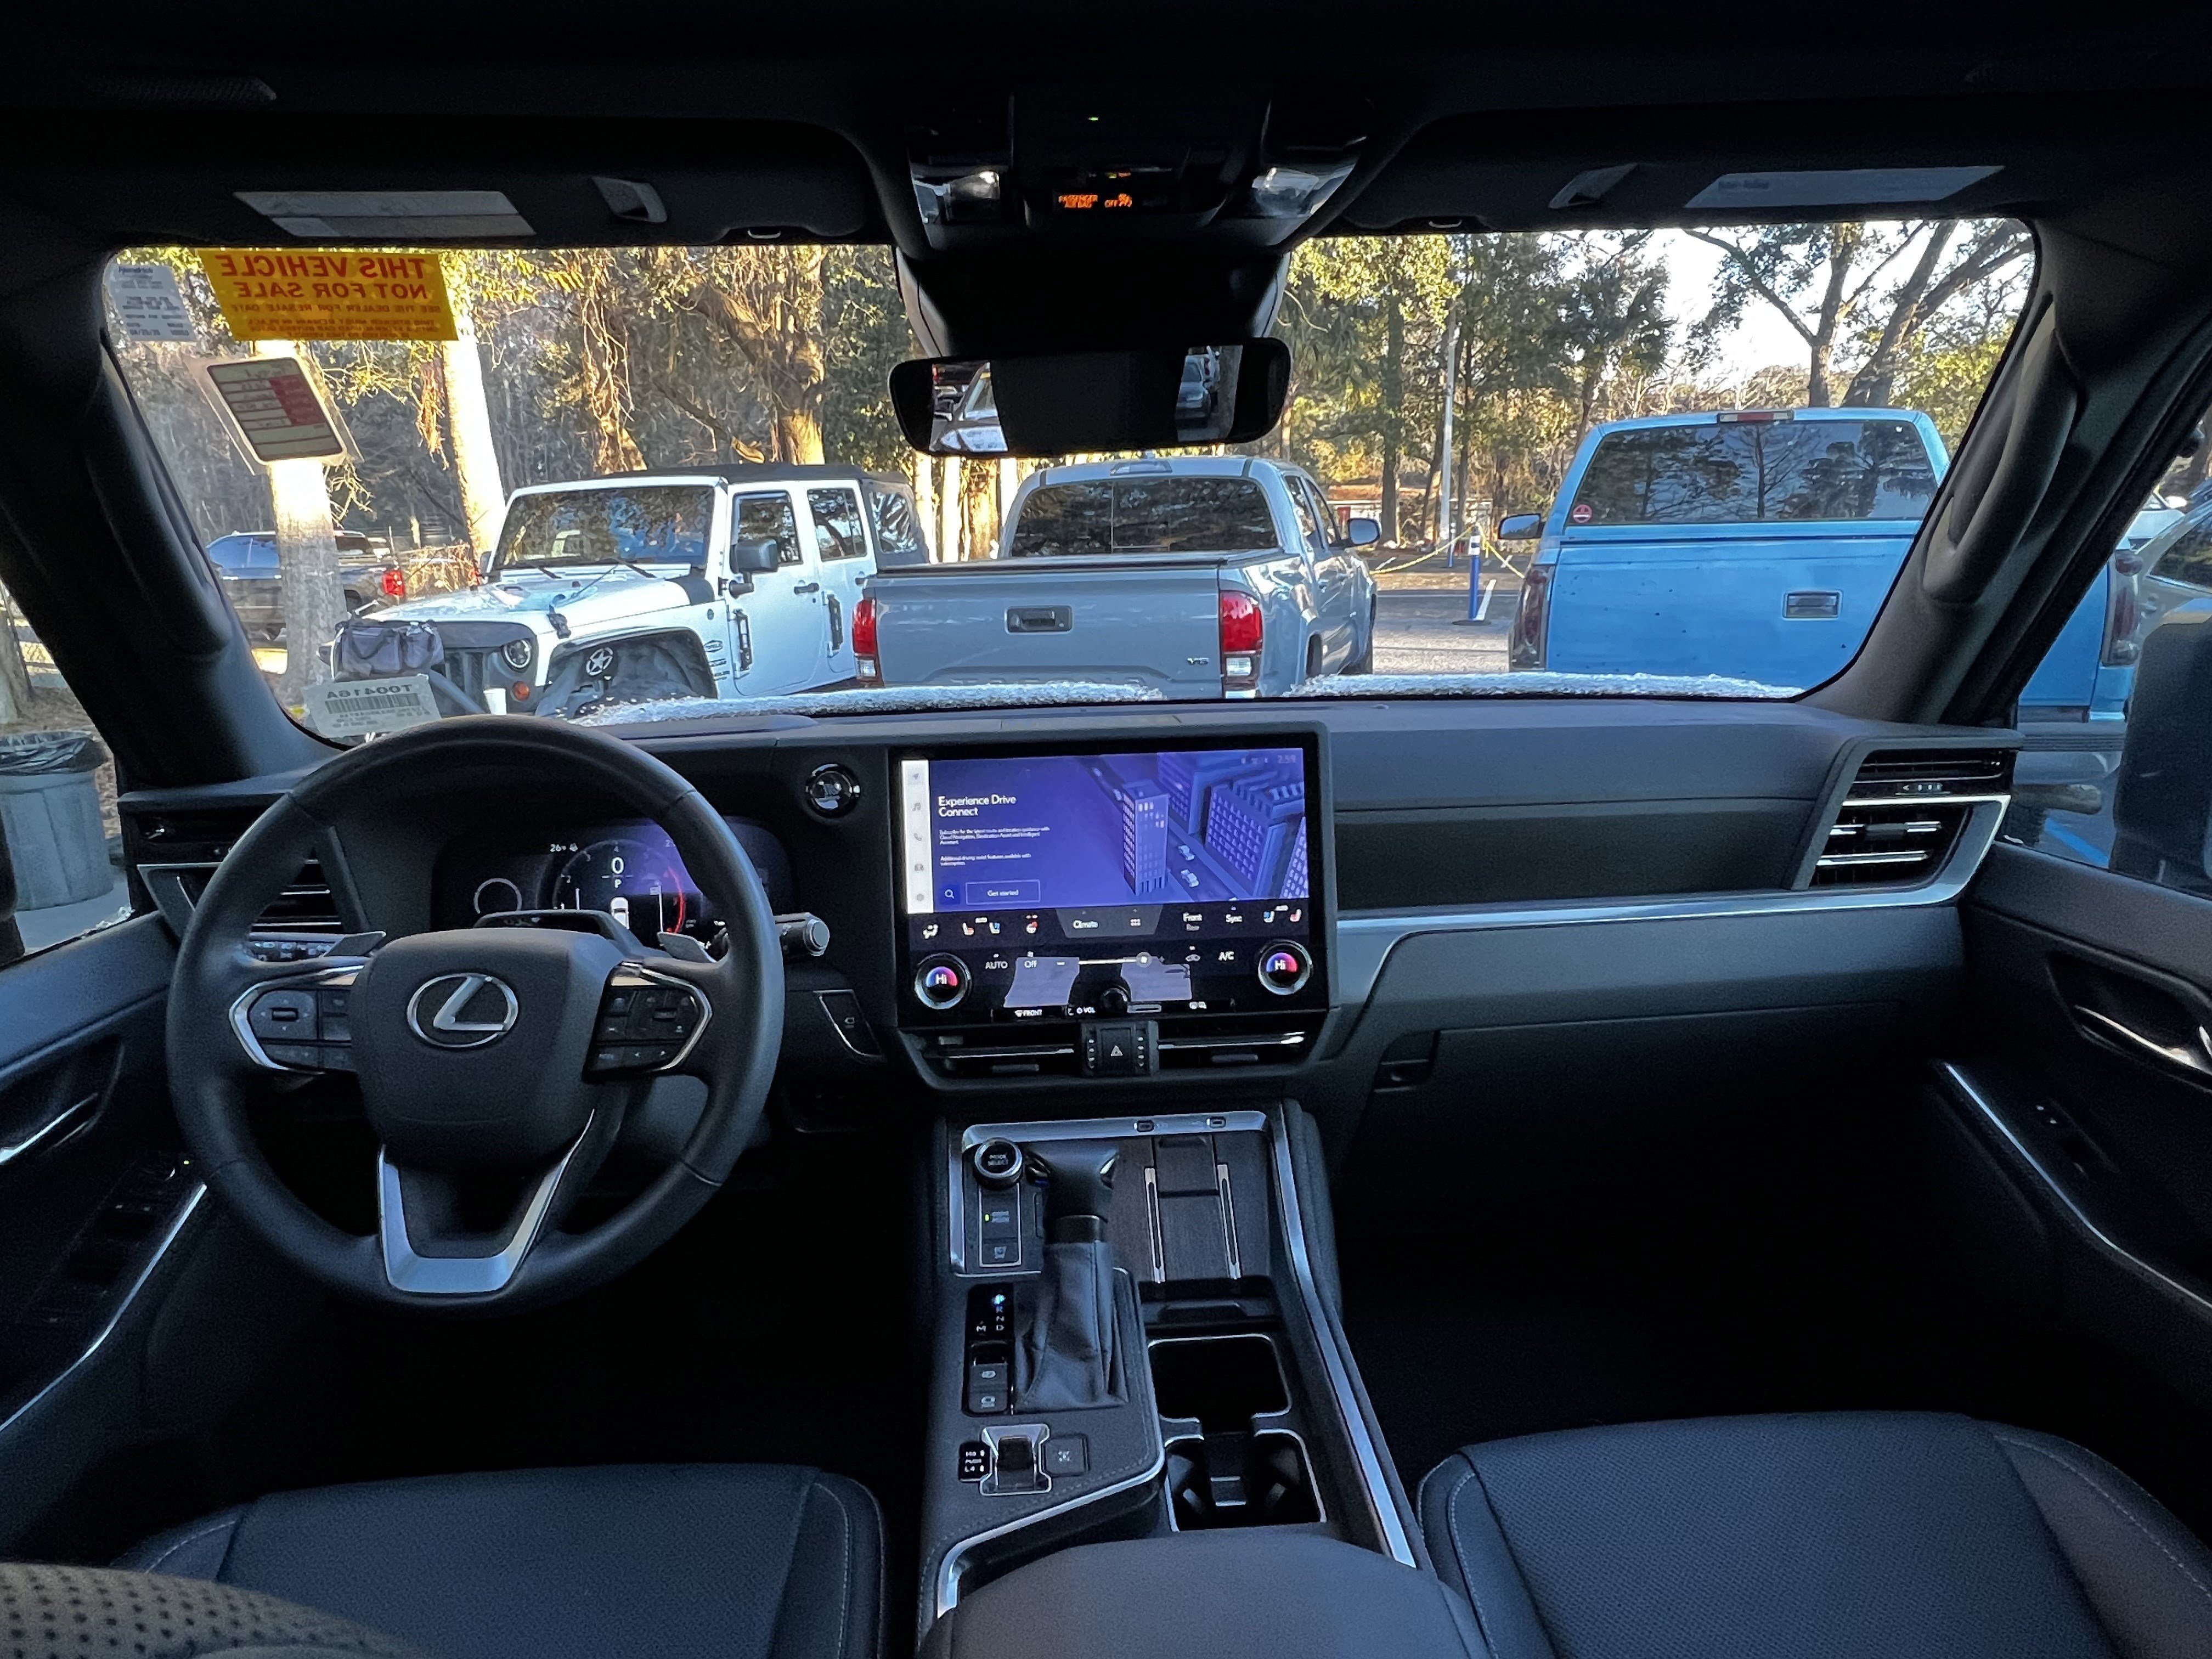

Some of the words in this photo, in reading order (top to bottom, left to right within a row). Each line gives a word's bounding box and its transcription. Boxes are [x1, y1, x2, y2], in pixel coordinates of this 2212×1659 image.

[939, 796, 989, 807] Experience
[991, 794, 1017, 805] Drive
[939, 807, 979, 817] Connect
[611, 856, 624, 874] 0
[614, 879, 622, 888] P
[1183, 912, 1203, 922] Front
[1226, 914, 1243, 923] Sync
[1218, 951, 1235, 961] A/C
[985, 961, 1008, 970] AUTO
[1024, 961, 1037, 969] Off
[1273, 959, 1286, 971] Hi
[935, 973, 947, 985] Hi
